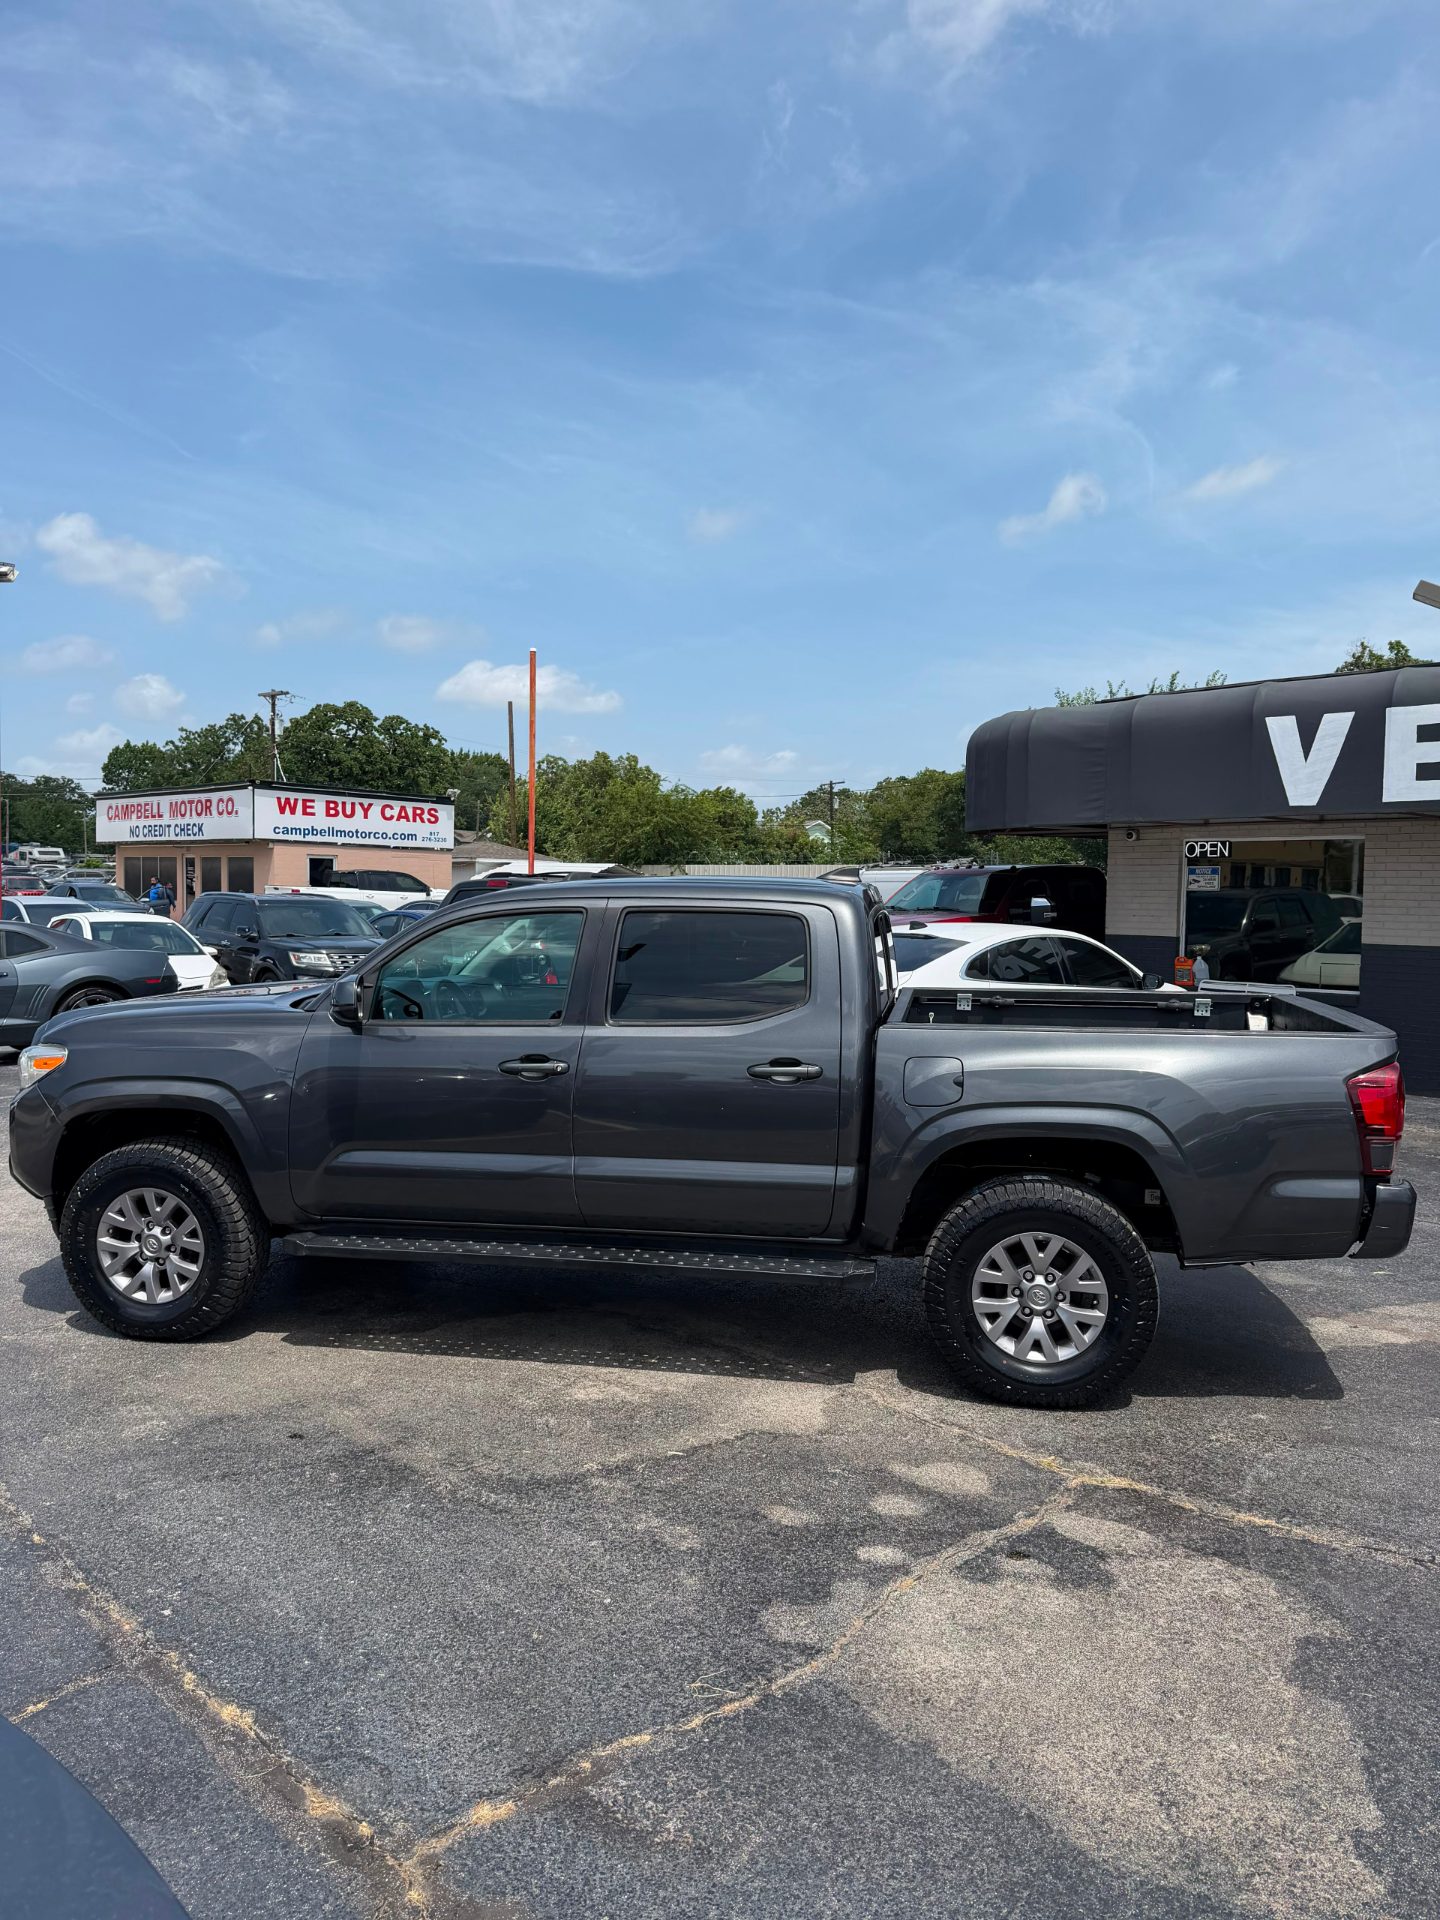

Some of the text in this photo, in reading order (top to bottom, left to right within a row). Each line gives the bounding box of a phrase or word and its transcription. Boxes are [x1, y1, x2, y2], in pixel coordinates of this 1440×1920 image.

[1265, 703, 1440, 807] VE
[107, 795, 239, 821] CAMPBELL MOTOR CO.
[276, 796, 440, 825] WE BUY CARS
[129, 822, 205, 838] NO CREDIT CHECK
[273, 824, 418, 842] campbellmotorco.com
[1185, 841, 1229, 858] OPEN
